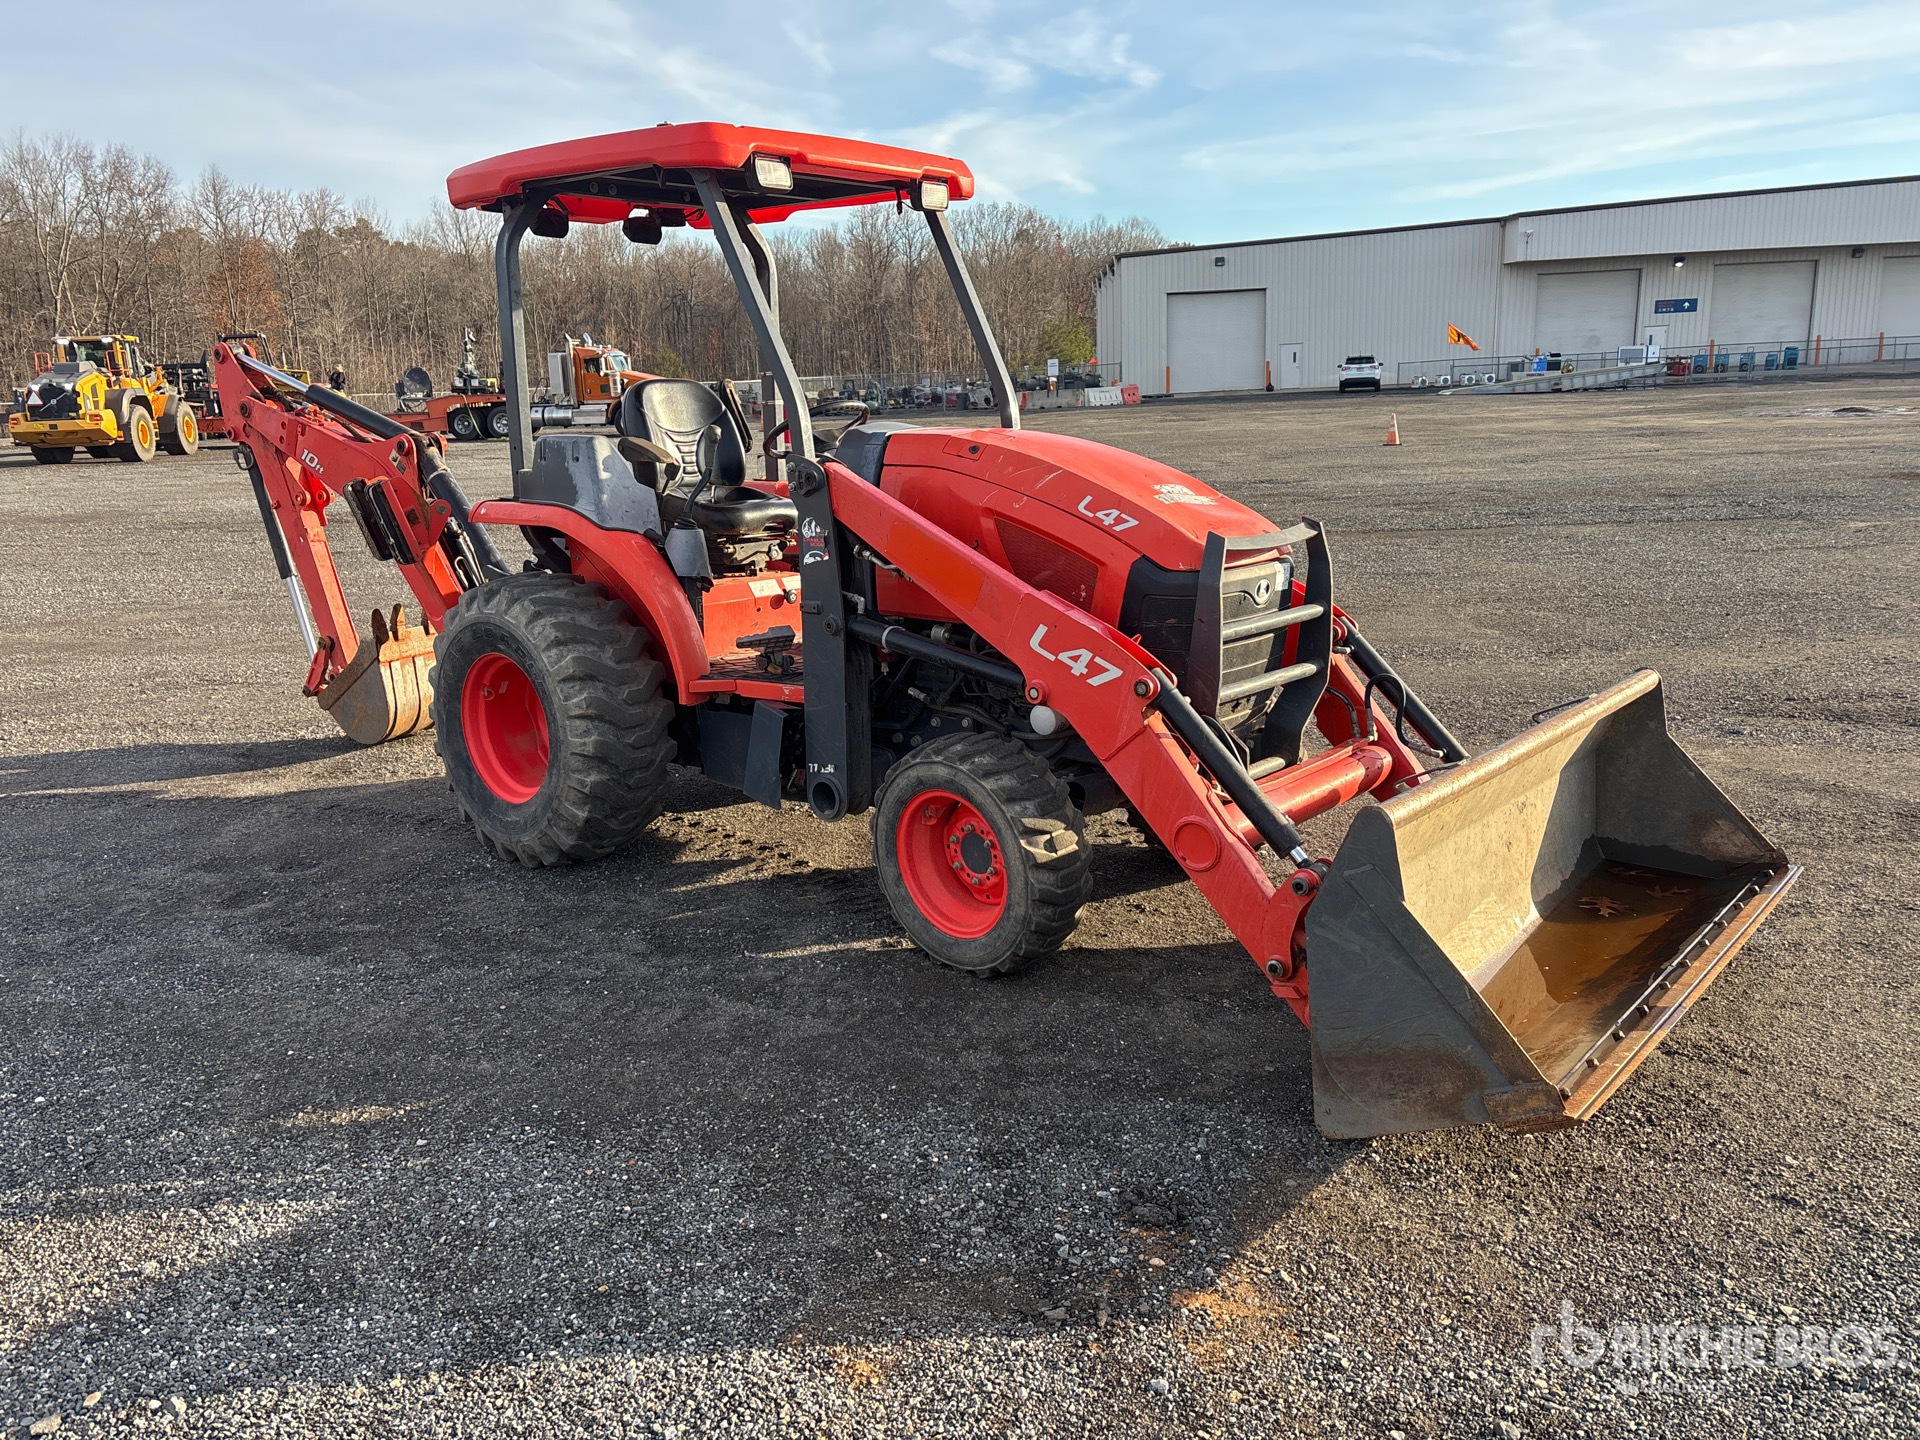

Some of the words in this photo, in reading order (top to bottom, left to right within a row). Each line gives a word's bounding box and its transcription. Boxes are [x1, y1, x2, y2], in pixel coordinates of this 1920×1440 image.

[301, 448, 325, 475] 10ft
[1078, 495, 1140, 532] L47
[1029, 623, 1124, 687] L47
